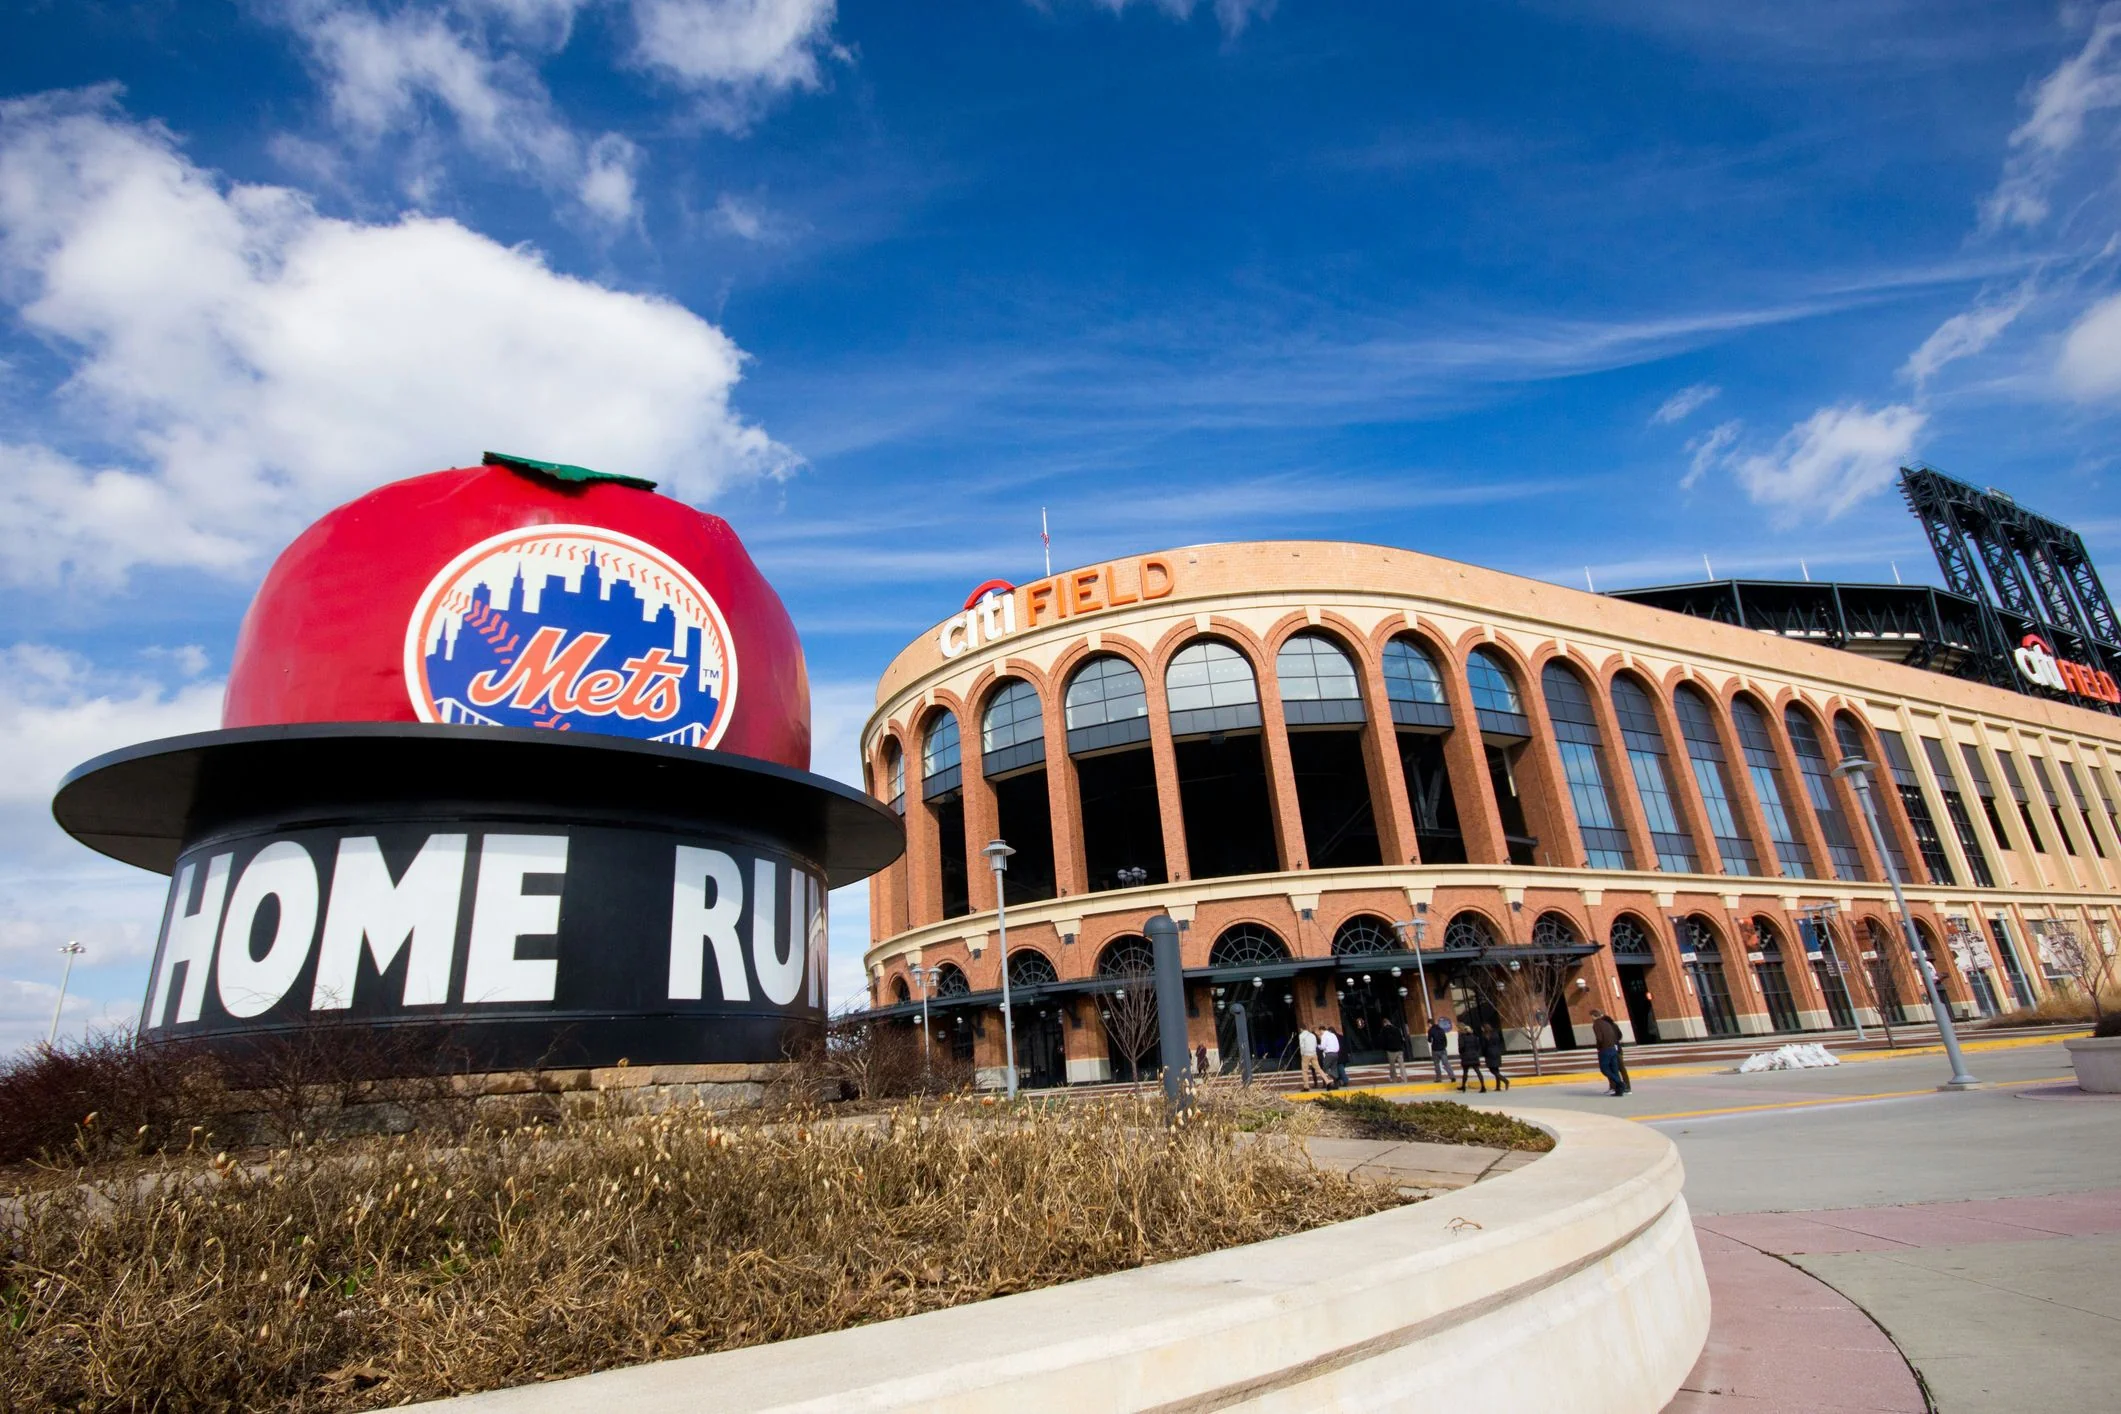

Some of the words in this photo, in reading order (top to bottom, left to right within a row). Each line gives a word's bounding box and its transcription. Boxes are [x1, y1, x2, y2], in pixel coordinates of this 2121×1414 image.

[940, 590, 1016, 658] citi
[1027, 557, 1175, 628] FIELD
[467, 626, 690, 722] Mets
[148, 833, 570, 1029] HOME
